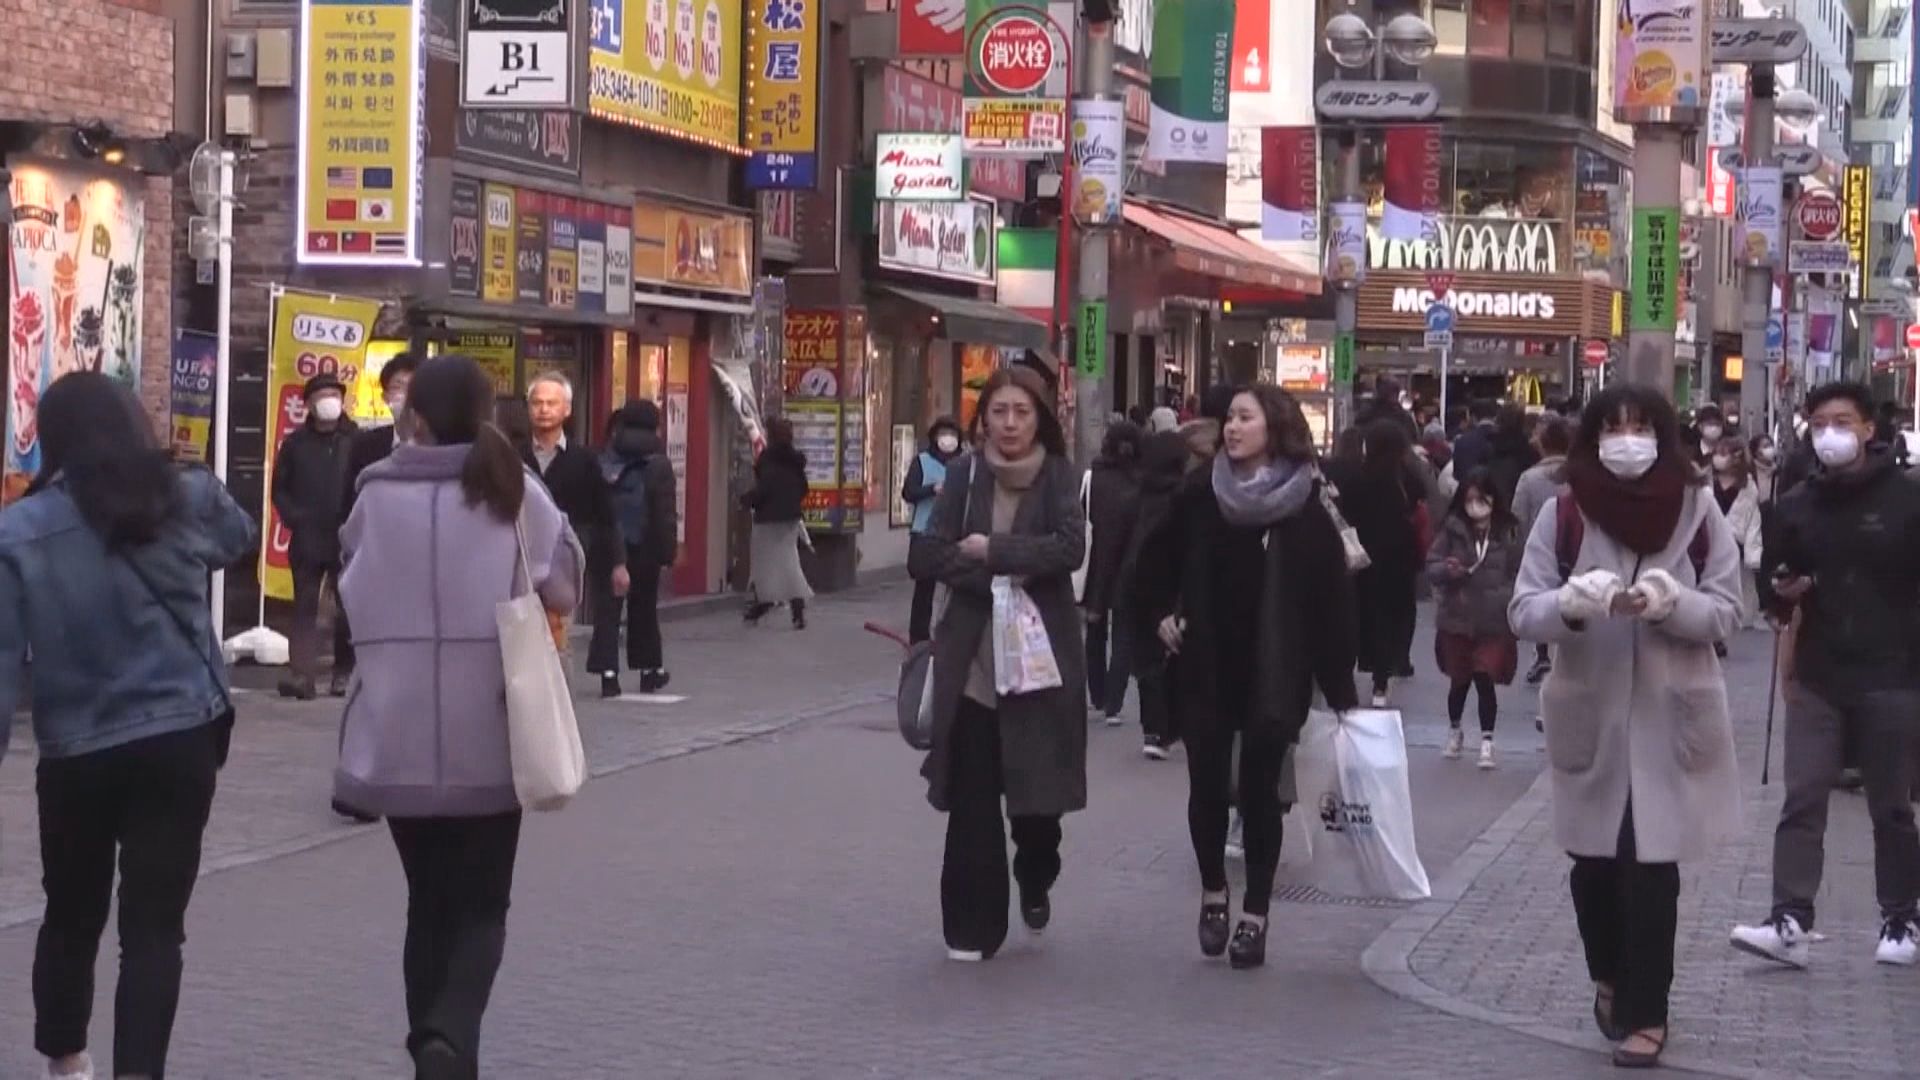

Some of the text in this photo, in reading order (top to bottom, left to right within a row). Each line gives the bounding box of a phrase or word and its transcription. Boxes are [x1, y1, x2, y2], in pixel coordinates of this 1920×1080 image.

[500, 41, 542, 71] B1
[645, 22, 668, 60] No.1
[673, 31, 696, 69] No.1
[762, 0, 806, 80] 松屋
[988, 40, 1048, 69] 消火栓
[700, 42, 722, 78] No.1
[1211, 32, 1228, 113] TOKYO 2020
[766, 154, 794, 166] 24h
[880, 150, 943, 168] Miami
[899, 207, 934, 249] Miami
[1392, 287, 1556, 319] McDonald's
